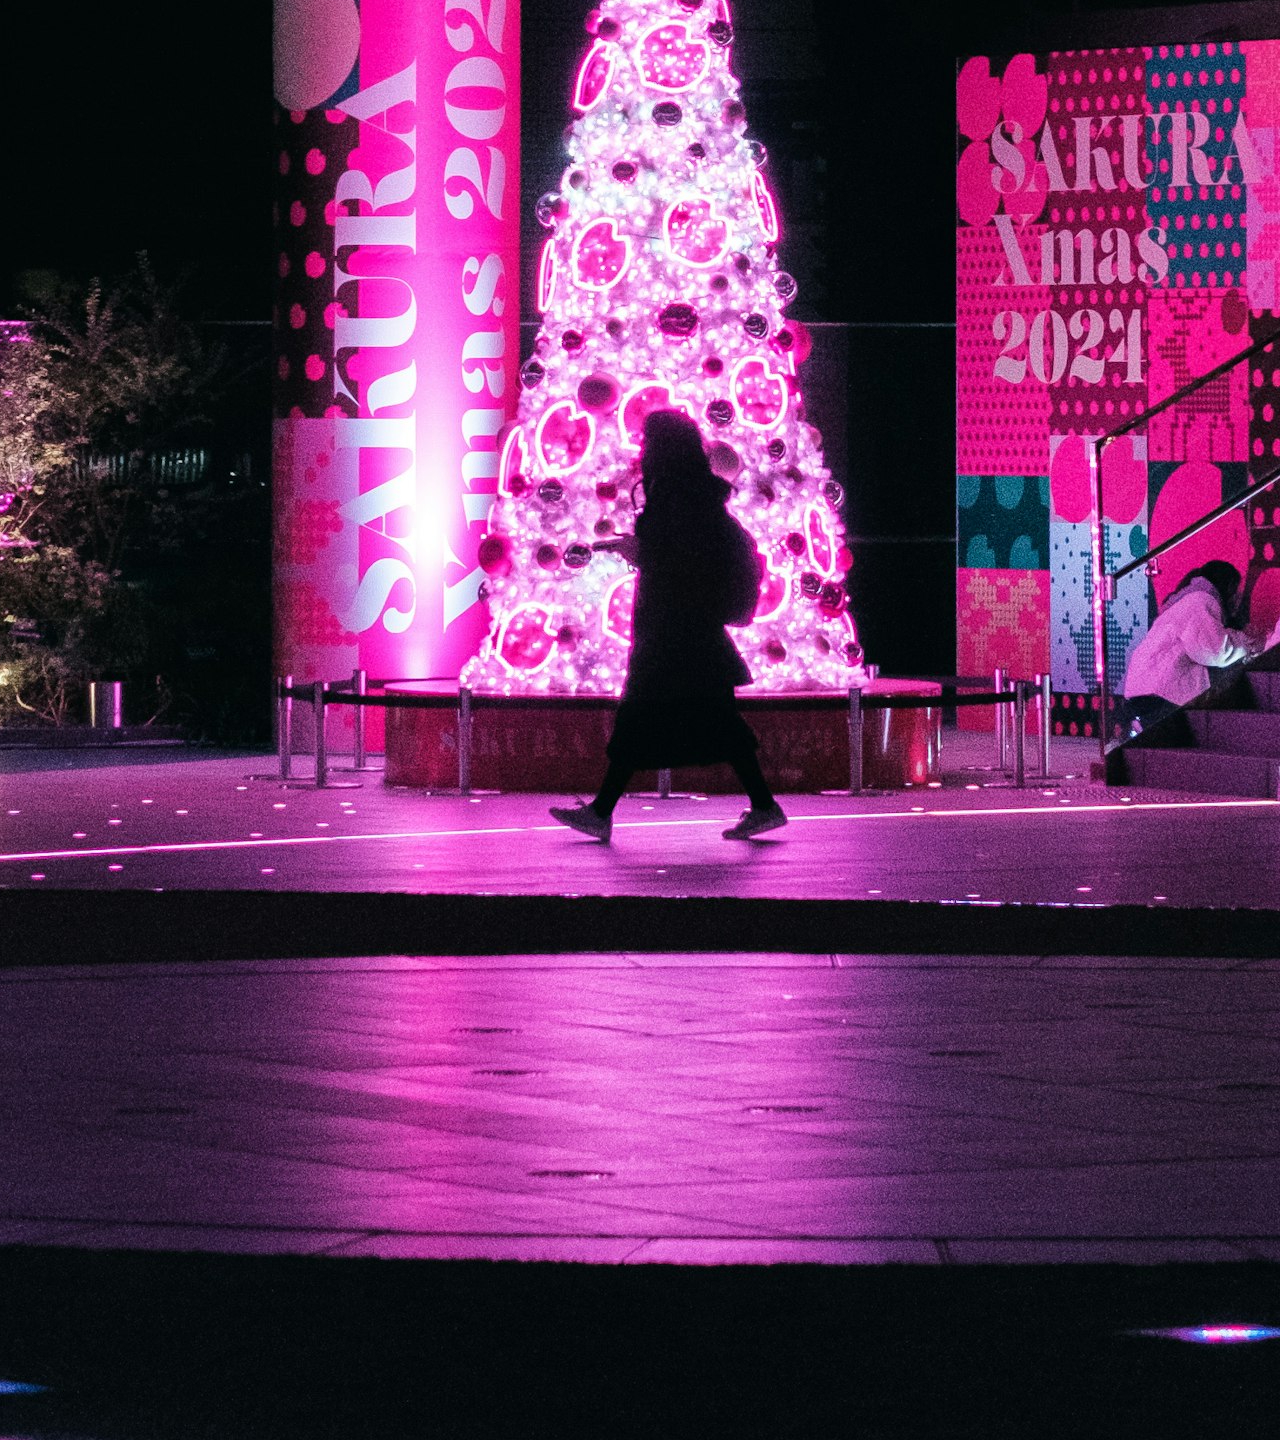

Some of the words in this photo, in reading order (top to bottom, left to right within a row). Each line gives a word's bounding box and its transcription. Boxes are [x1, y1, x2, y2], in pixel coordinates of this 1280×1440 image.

[990, 111, 1264, 194] SAKURA
[990, 213, 1170, 287] Xmas
[333, 57, 417, 634] SAKURA
[992, 308, 1148, 384] 2024
